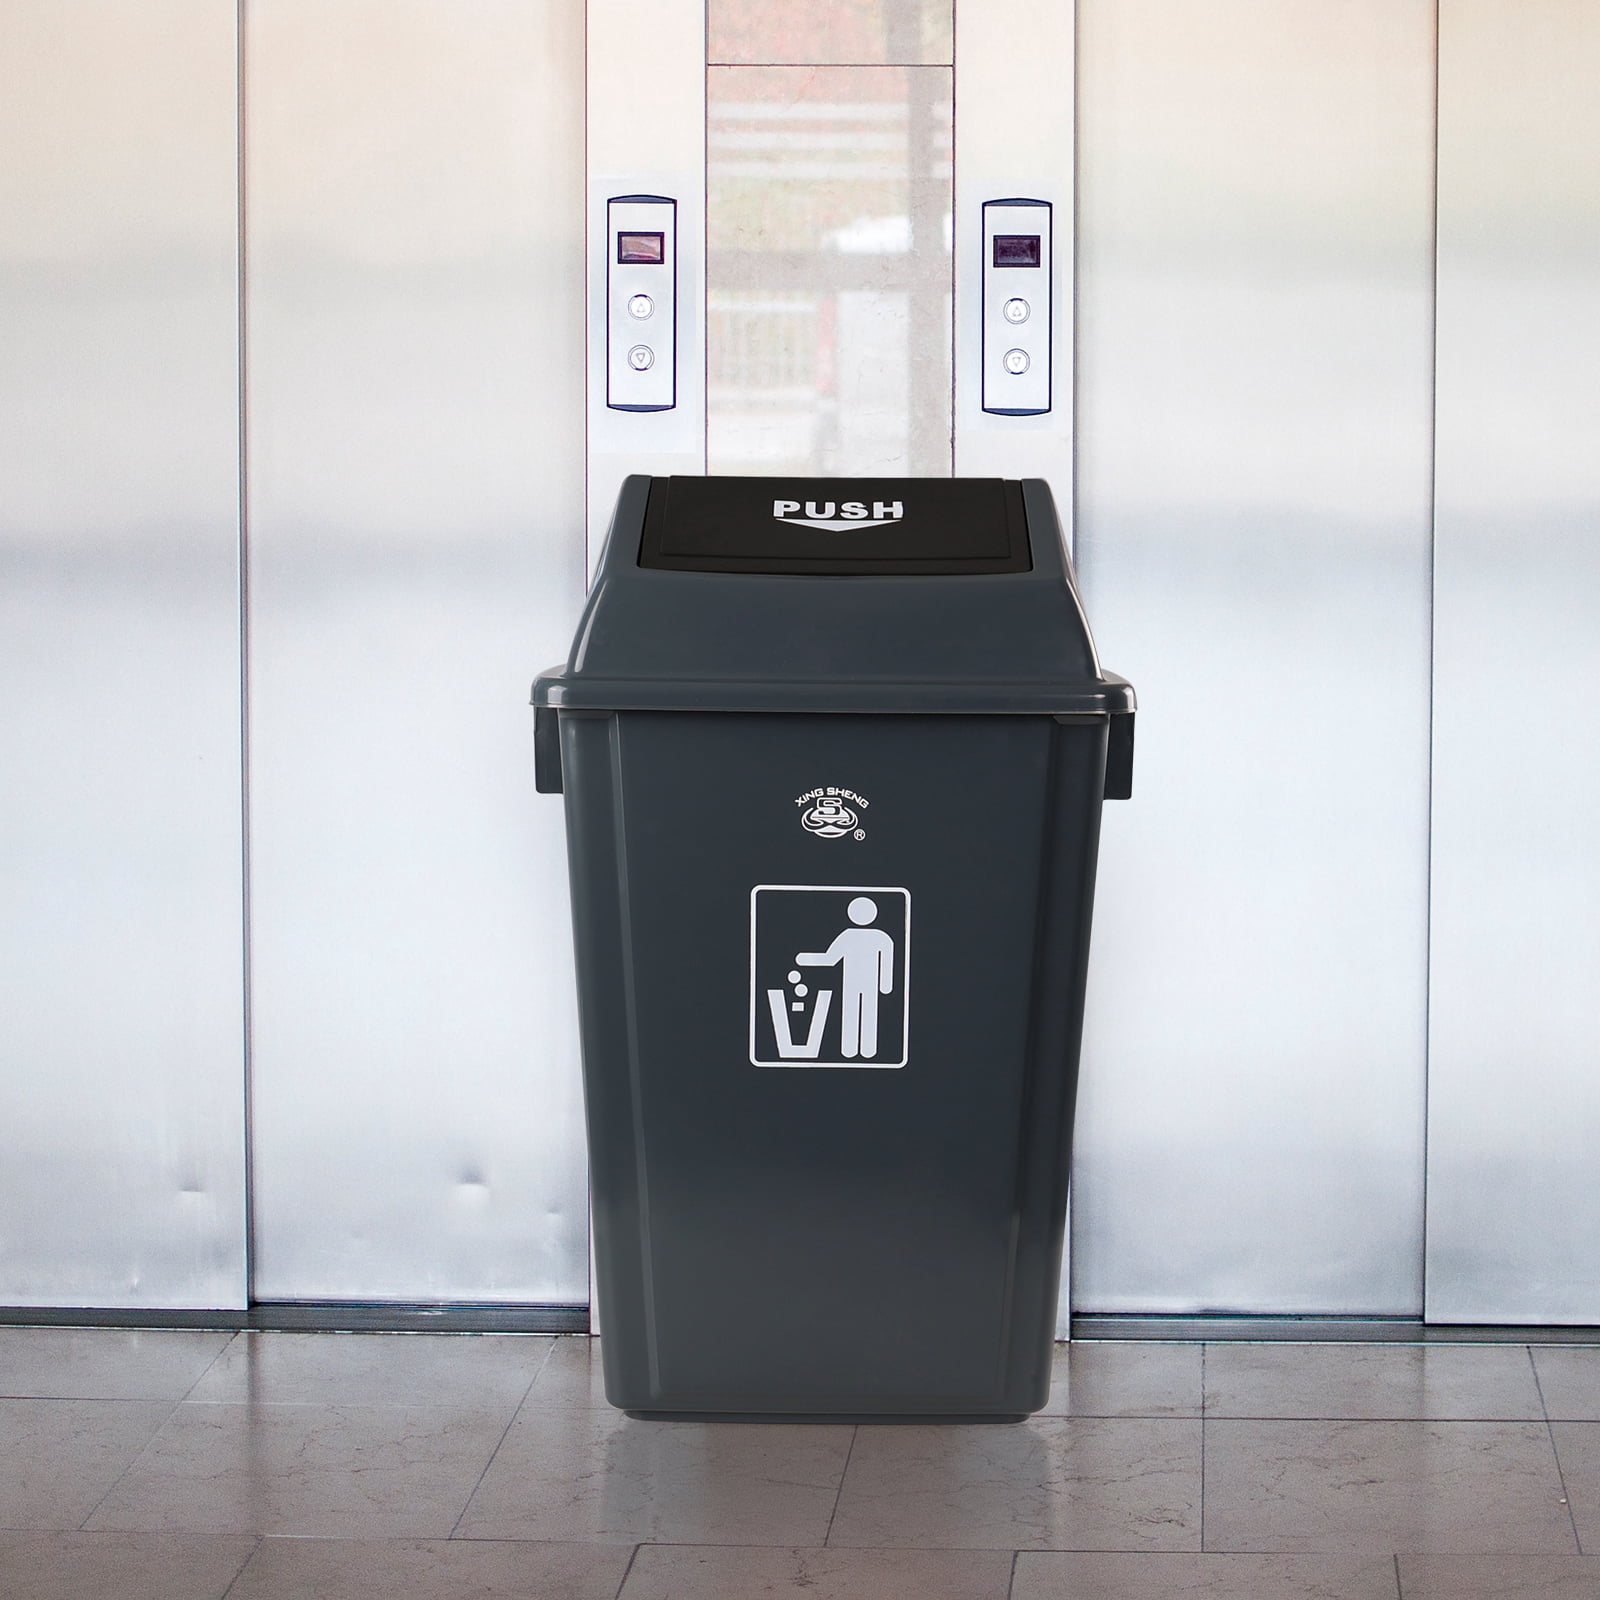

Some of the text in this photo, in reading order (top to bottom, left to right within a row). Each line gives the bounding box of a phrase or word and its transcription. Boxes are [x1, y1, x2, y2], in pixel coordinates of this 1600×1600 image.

[773, 500, 904, 519] PUSH
[795, 787, 869, 809] XING SHENG
